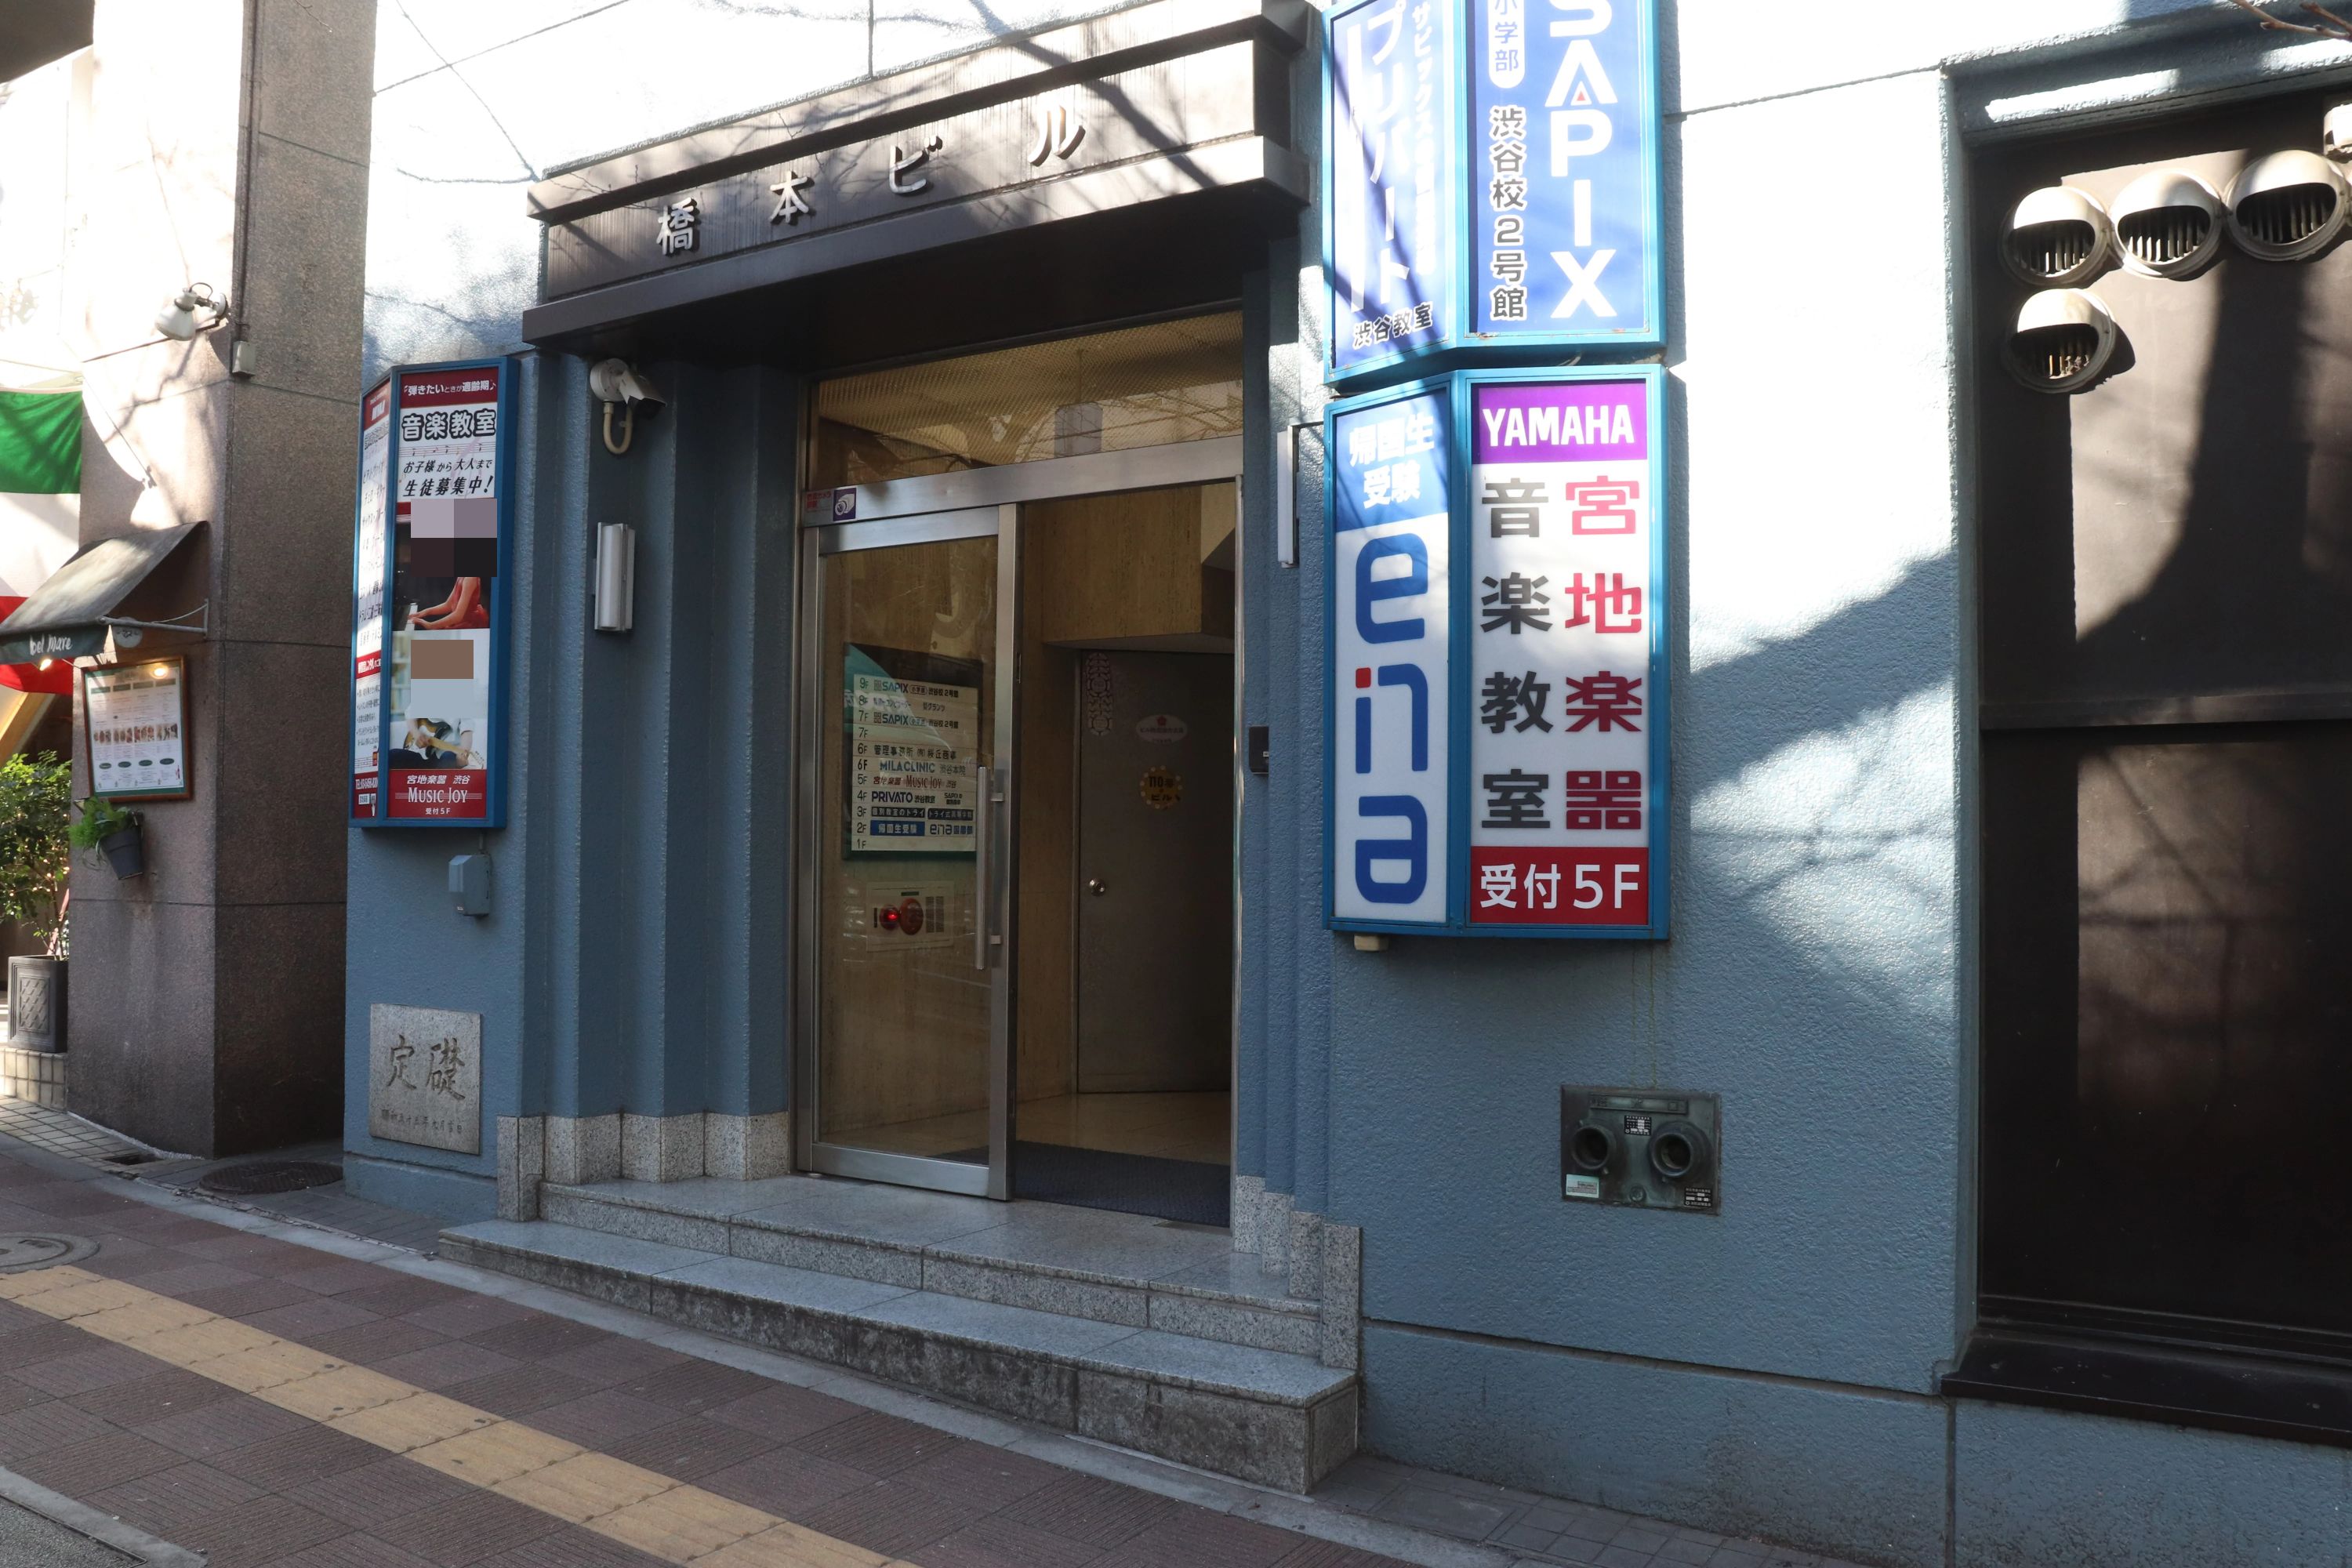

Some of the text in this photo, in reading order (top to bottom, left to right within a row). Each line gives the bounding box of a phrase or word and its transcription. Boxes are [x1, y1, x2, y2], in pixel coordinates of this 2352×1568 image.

[656, 104, 1086, 256] 橋本ビル
[1544, 0, 1619, 318] SAPIX
[1491, 107, 1526, 319] 渋谷校2号館
[1353, 302, 1434, 349] 渋谷教室
[401, 408, 496, 441] 音楽教室
[1348, 412, 1435, 468] 帰国生
[1482, 405, 1635, 447] YAMAHA
[402, 475, 494, 497] 生徒募集中!
[1363, 461, 1421, 509] 受験
[1480, 476, 1554, 829] 音楽教室
[1565, 475, 1643, 831] 宮地楽器
[882, 681, 909, 693] SAPIX
[882, 713, 909, 725] SAPIX
[407, 775, 470, 785] 宮地楽器 渋谷
[858, 759, 868, 770] 6F
[408, 786, 468, 804] MUSIC JOY
[871, 791, 913, 804] PRIVATO
[878, 824, 917, 834] 帰国生受験
[1479, 862, 1641, 911] 受付5F
[387, 1034, 466, 1101] 定礎
